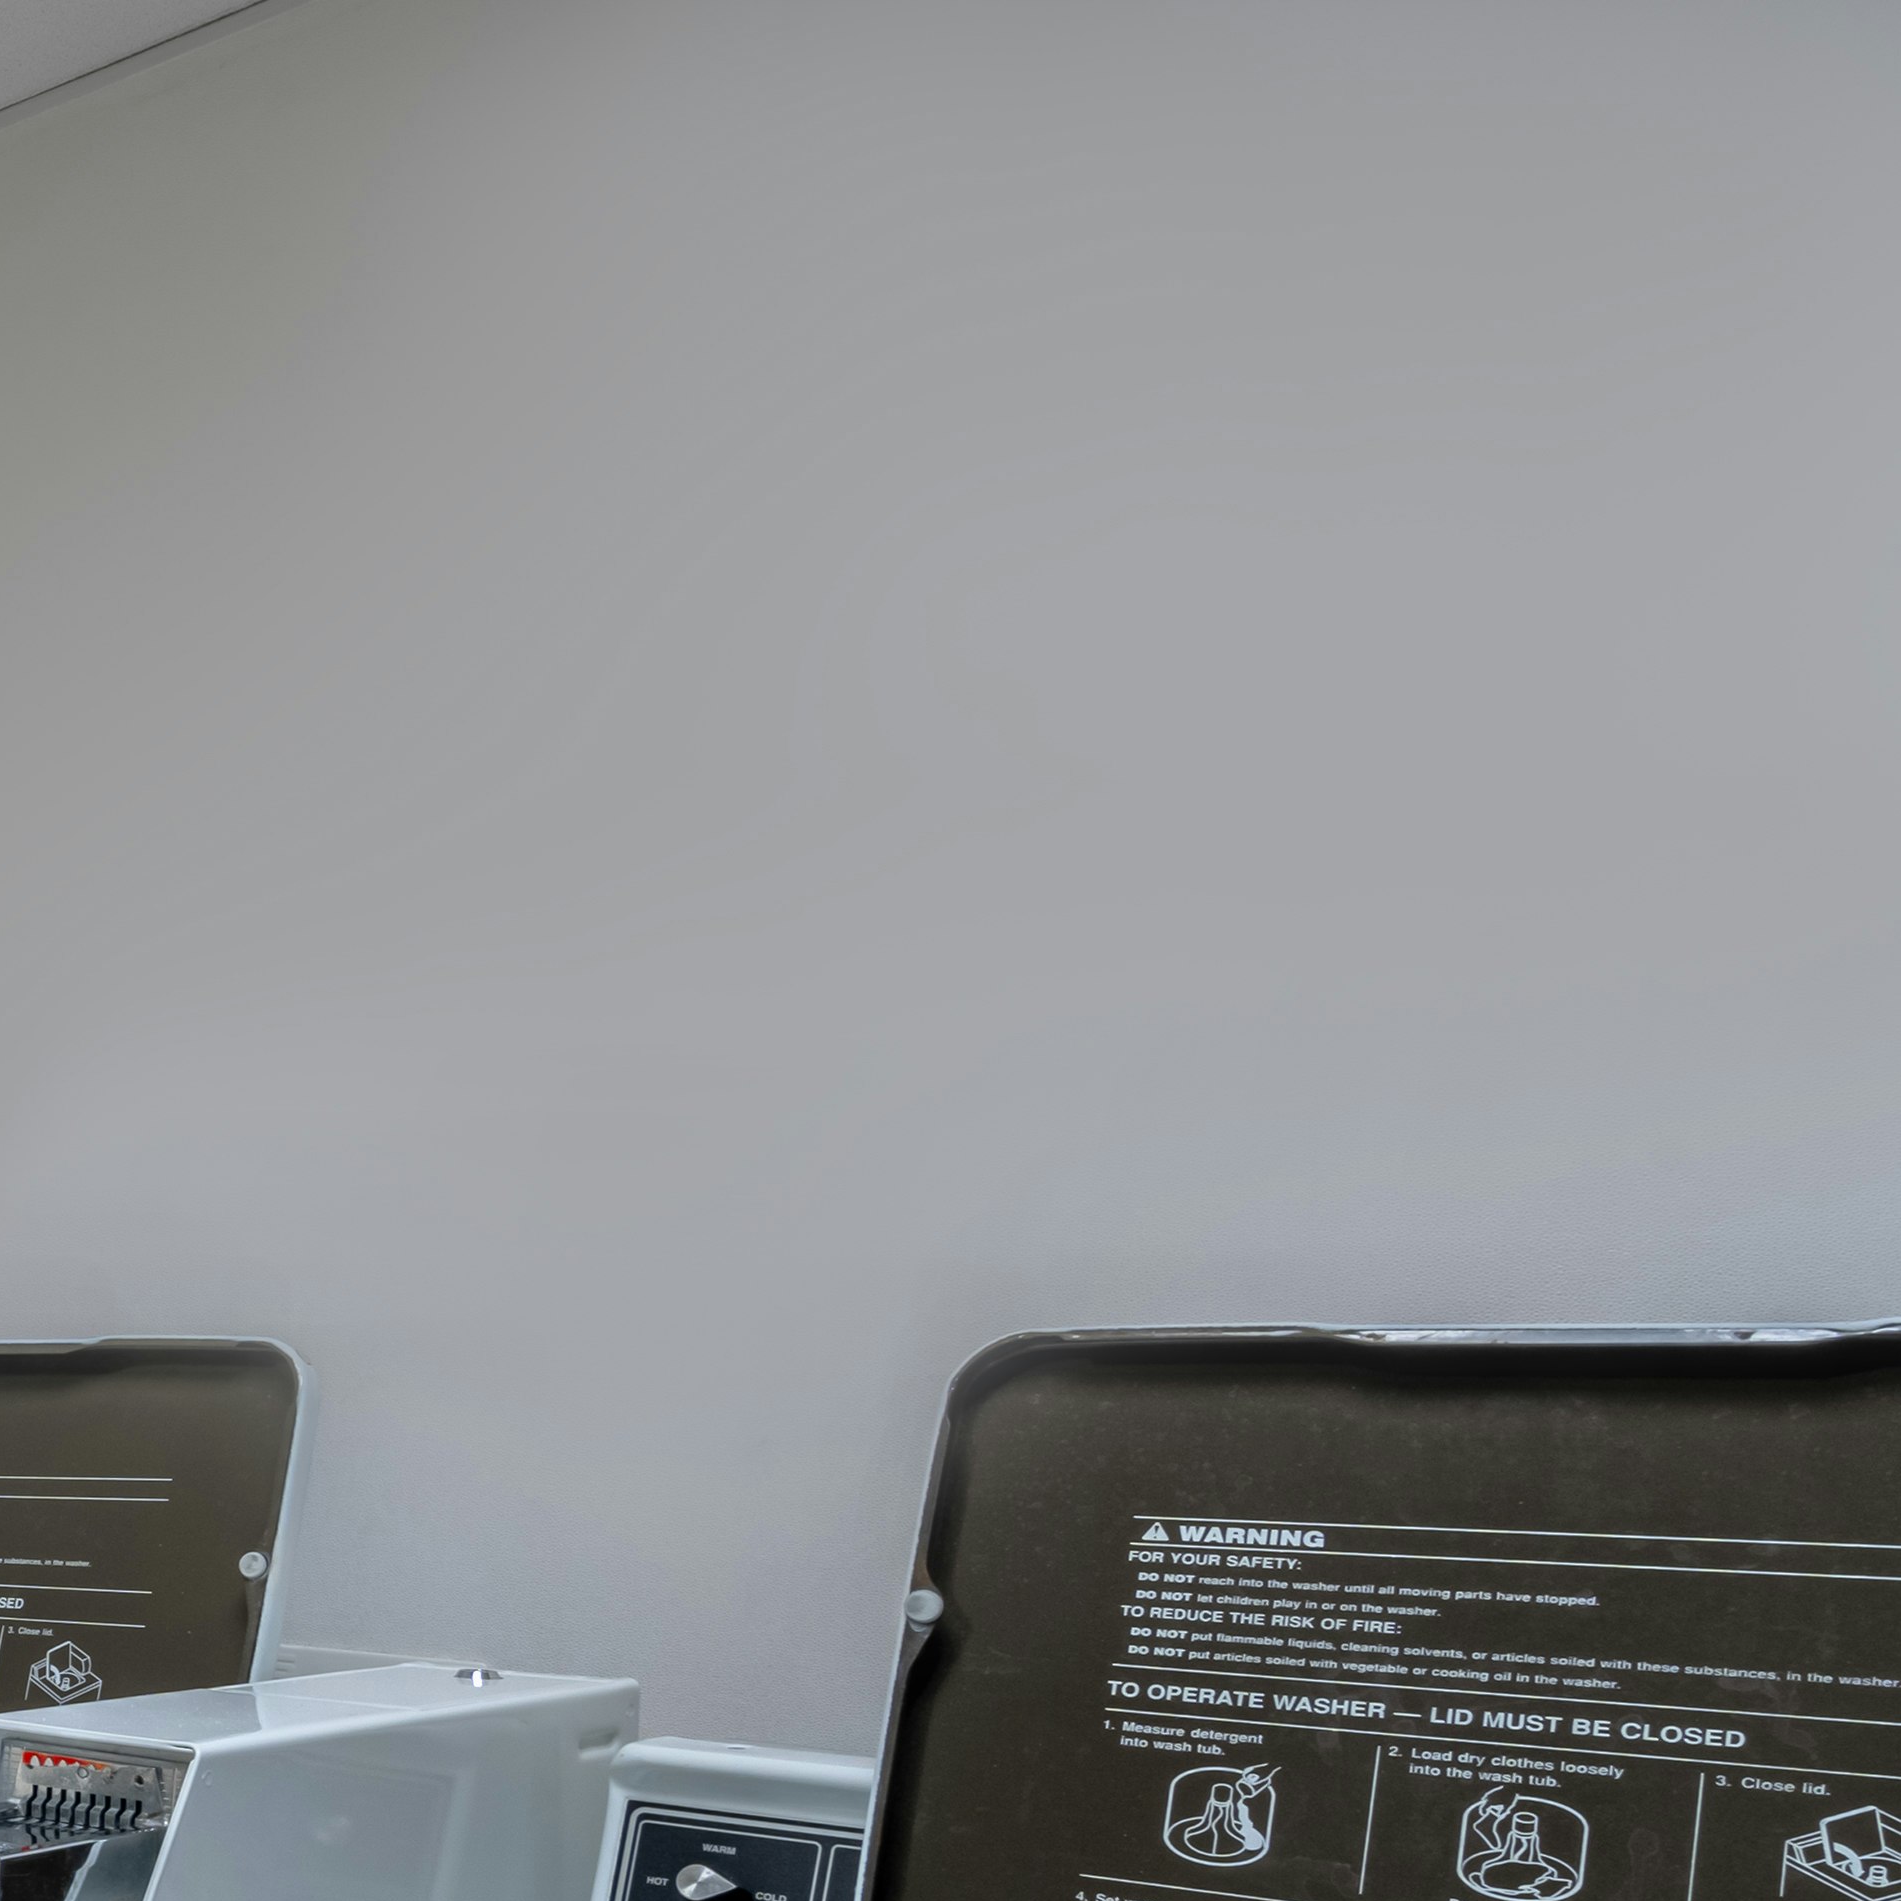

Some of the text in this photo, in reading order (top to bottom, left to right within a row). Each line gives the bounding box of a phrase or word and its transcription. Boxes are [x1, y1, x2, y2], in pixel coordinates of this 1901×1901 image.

[1179, 1525, 1325, 1548] WARNING
[1128, 1550, 1302, 1570] FOR YOUR SAFETY:
[1138, 1572, 1600, 1607] DO NOT reach into the washer until all moving parts have stopped.
[1121, 1605, 1402, 1634] TO REDUCE THE RISK OF FIRE:
[1107, 1680, 1746, 1748] TO OPERATE WASHER LID MUST BE CLOSED
[1104, 1720, 1263, 1744] 1. Measure detergent
[1388, 1745, 1624, 1779] 2. Load dry clothes loosely
[1715, 1775, 1831, 1796] 3. Close lid.
[702, 1843, 737, 1855] WARM
[646, 1876, 669, 1886] HOT
[1075, 1891, 1088, 1901] 4.
